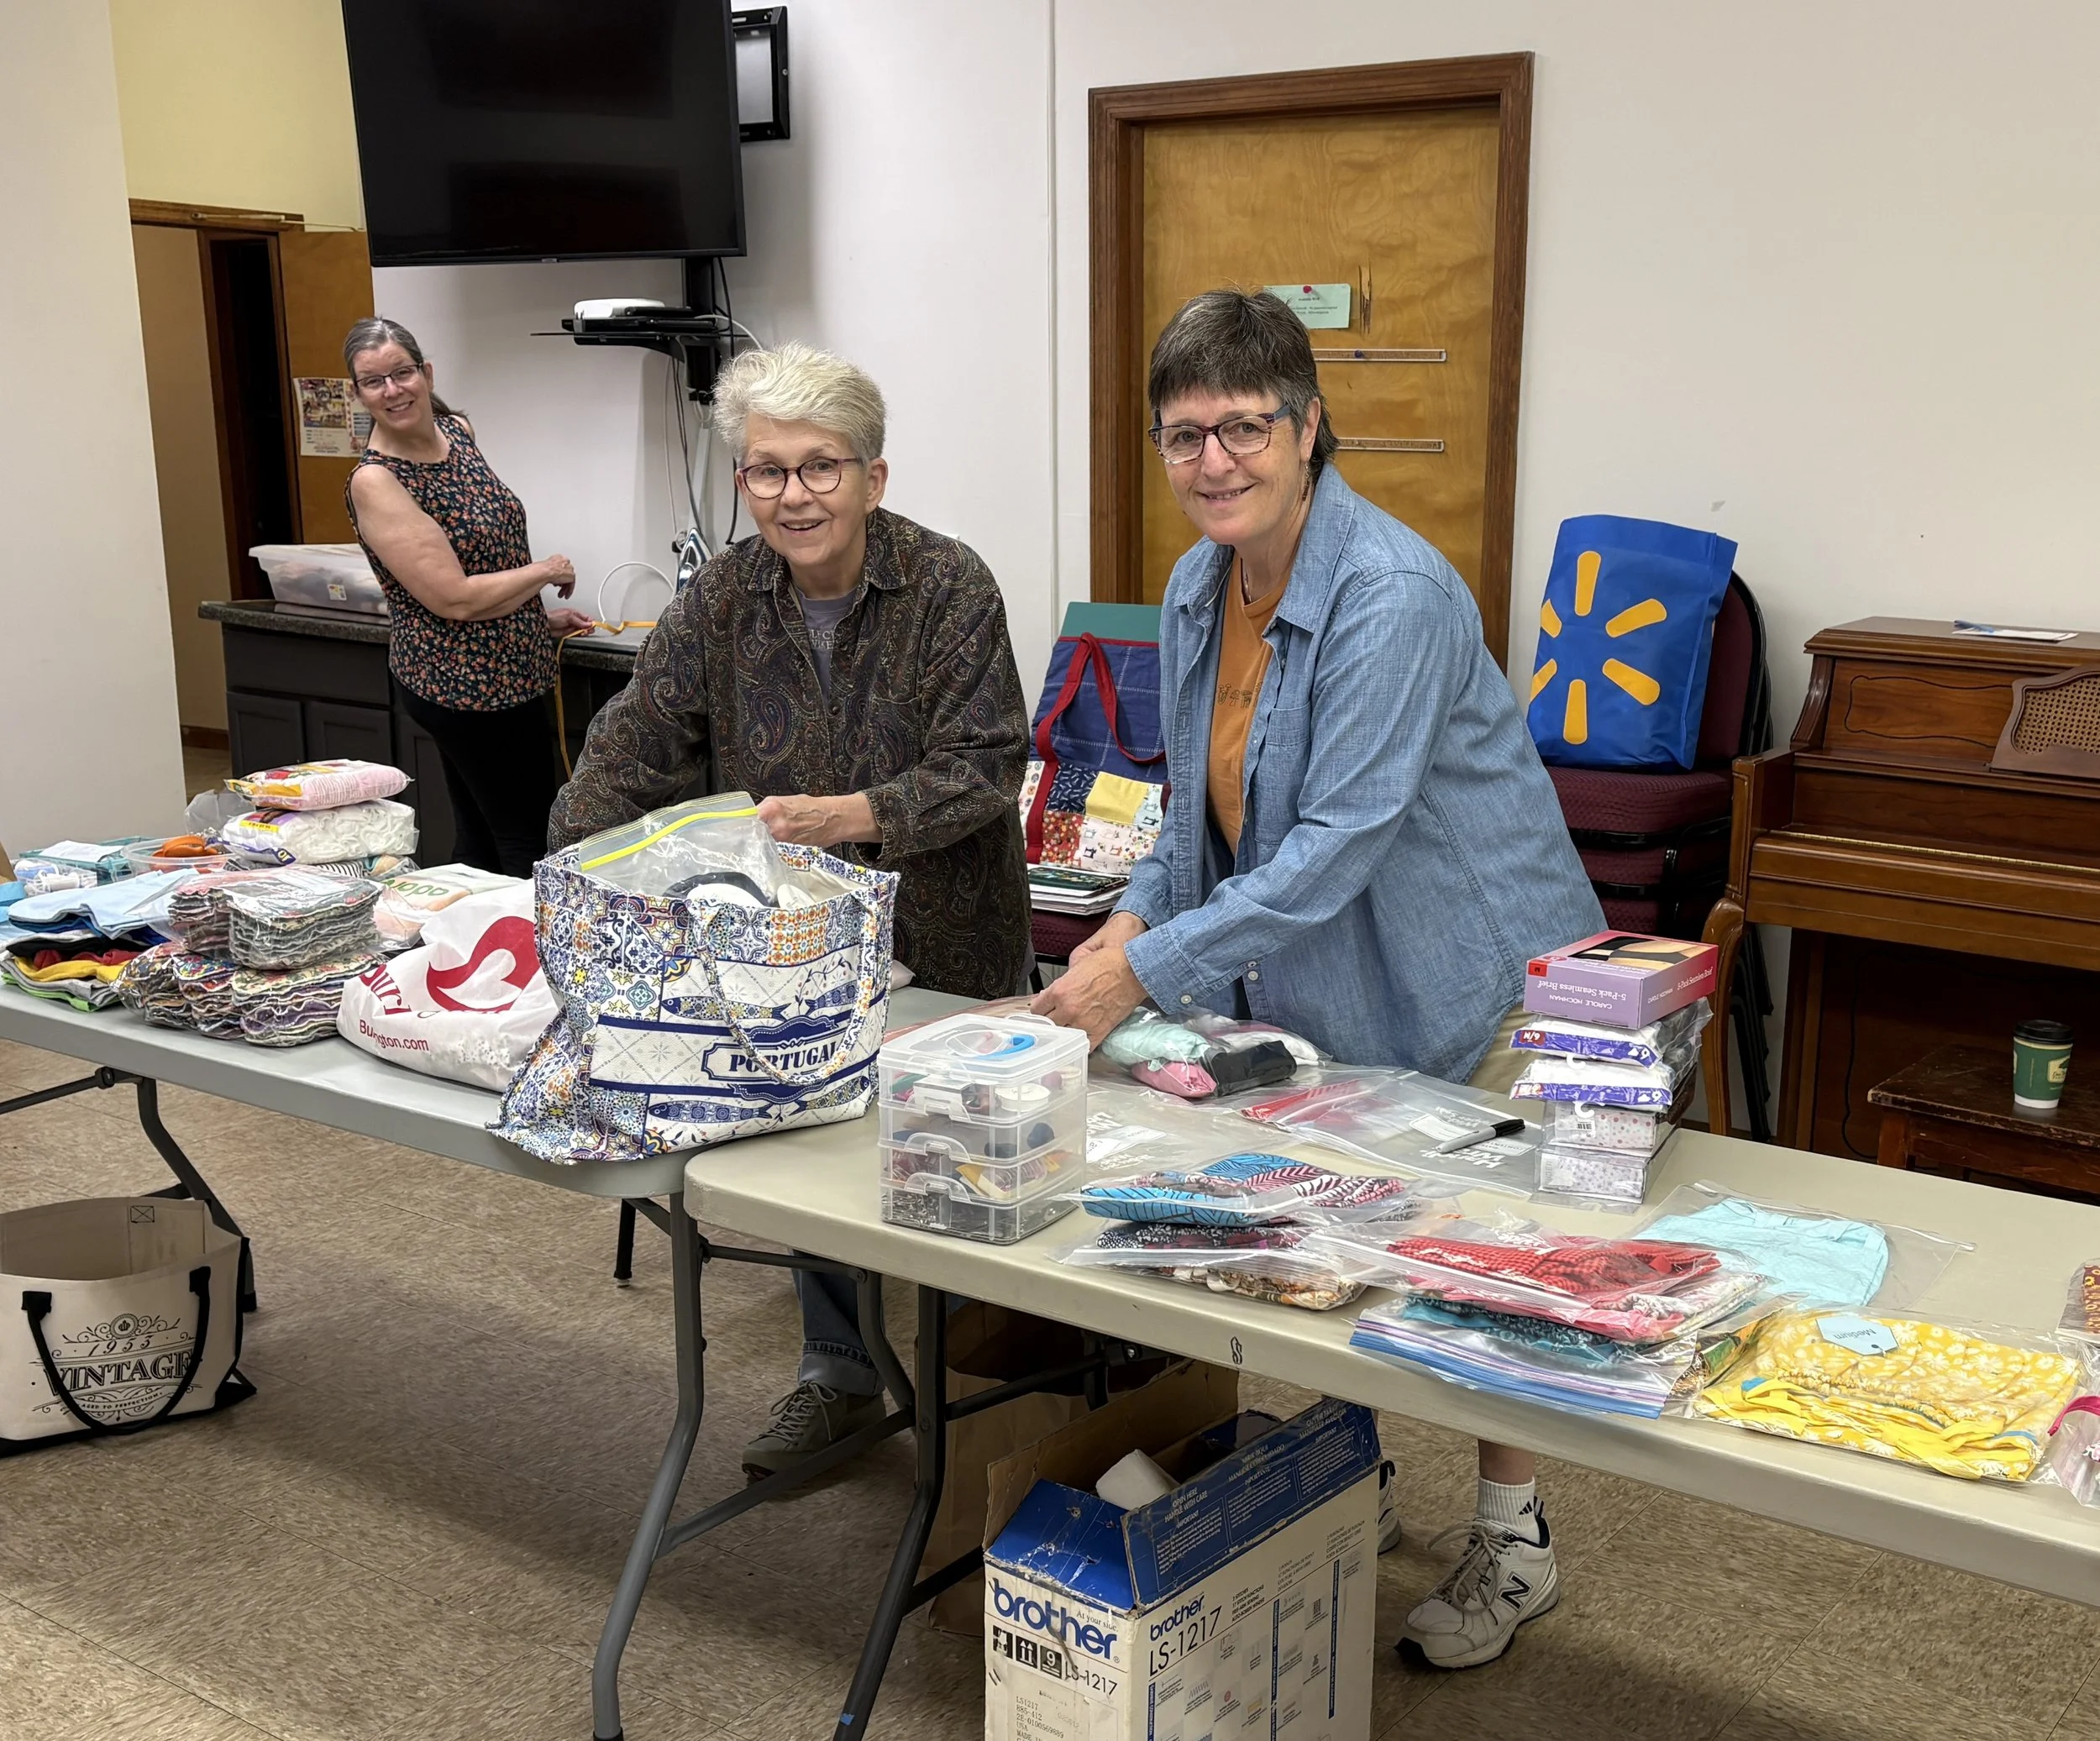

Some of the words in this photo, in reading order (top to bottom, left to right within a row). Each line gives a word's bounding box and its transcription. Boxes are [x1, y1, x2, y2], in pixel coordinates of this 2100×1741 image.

[1537, 980, 1558, 990] Brief
[1559, 983, 1598, 996] Seamless
[1599, 988, 1627, 1000] 5-Pack
[1549, 994, 1583, 1004] HOCHMAN
[1585, 999, 1613, 1009] CAROLE
[360, 1019, 429, 1051] Bugton.com
[728, 1041, 837, 1072] PORTUGAL
[1832, 1328, 1877, 1340] Medium
[87, 1335, 154, 1357] 1953
[44, 1347, 194, 1397] VINTAGE
[992, 1577, 1117, 1660] brother
[1076, 1609, 1084, 1619] At
[1086, 1614, 1101, 1625] your
[1150, 1595, 1205, 1641] brother
[1149, 1605, 1223, 1677] LS-1217
[1065, 1661, 1118, 1696] LS-1217
